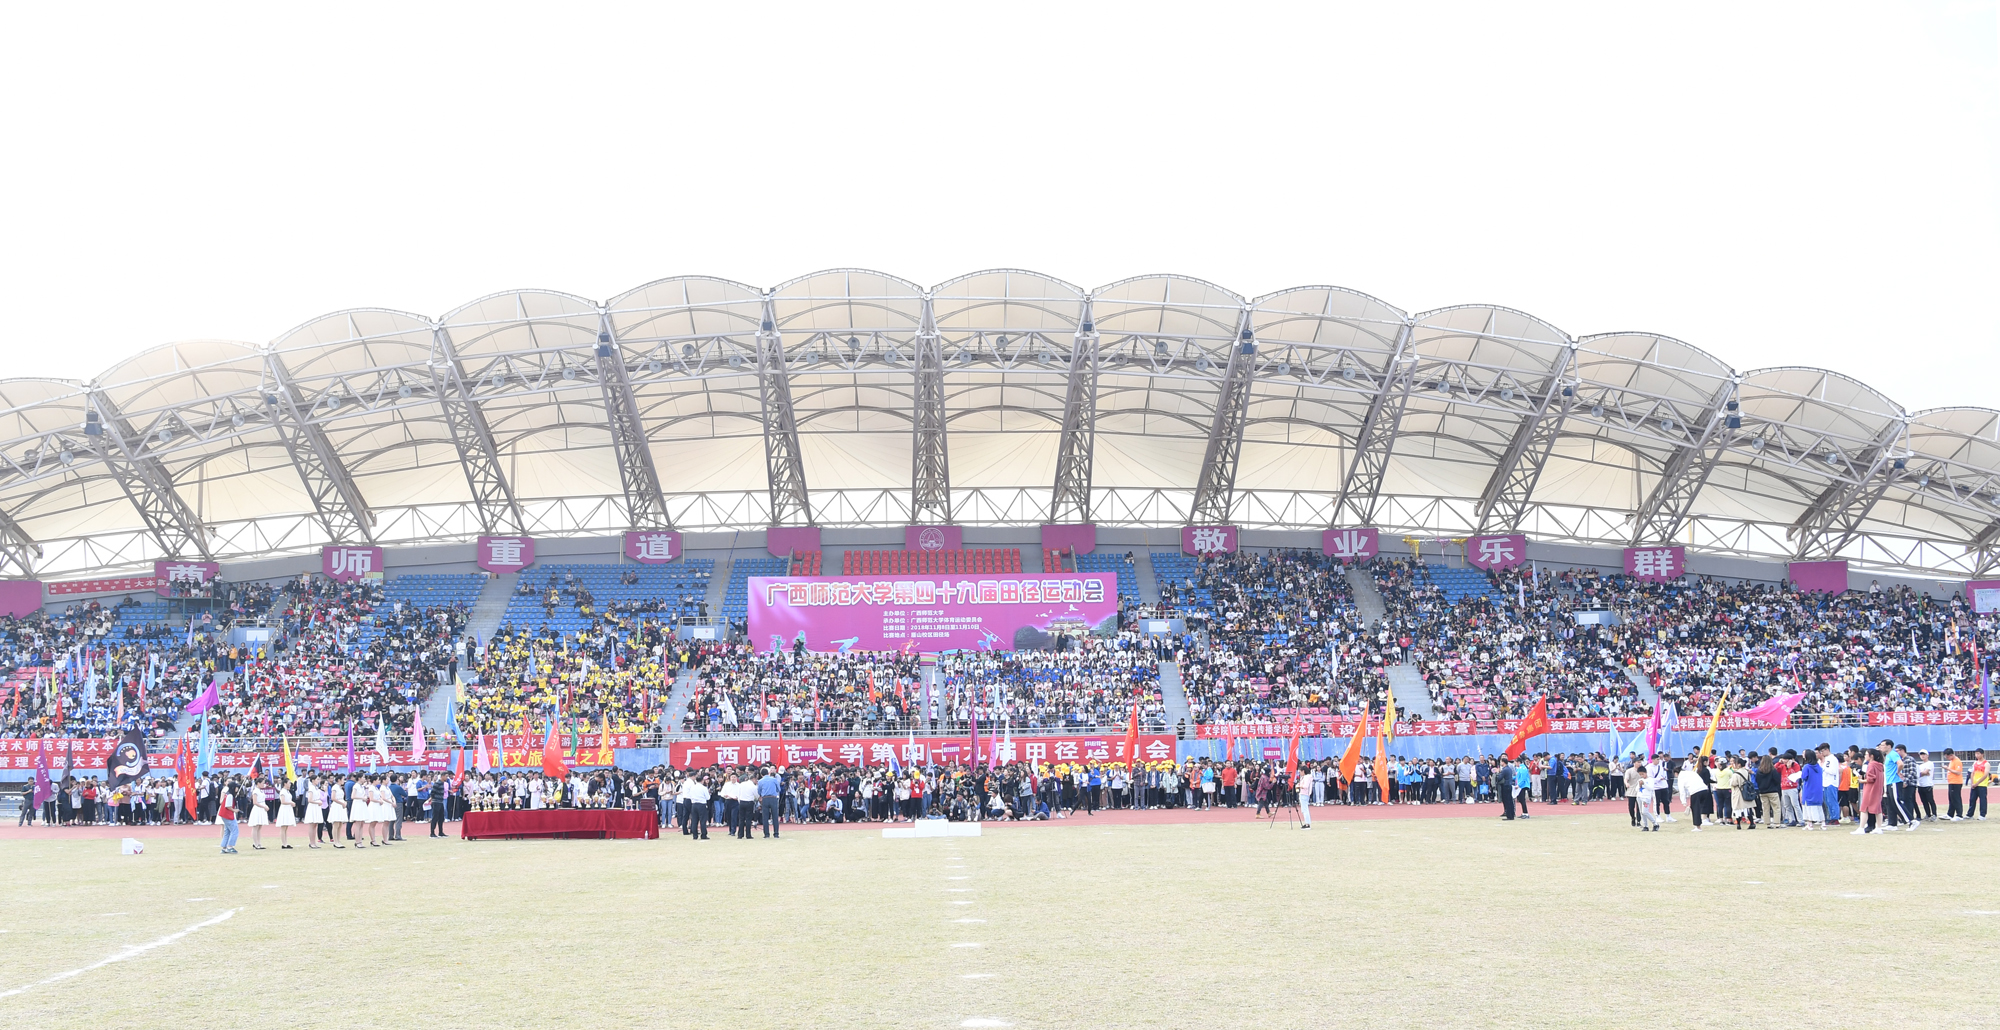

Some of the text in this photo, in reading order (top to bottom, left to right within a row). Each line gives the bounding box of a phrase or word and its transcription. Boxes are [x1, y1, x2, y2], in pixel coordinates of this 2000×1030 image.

[487, 539, 526, 566] 重
[636, 534, 673, 560] 道
[1193, 529, 1228, 554] 敬
[1334, 531, 1371, 557] 业
[1479, 538, 1515, 563] 乐
[332, 550, 372, 577] 师
[1634, 550, 1674, 577] 群
[766, 578, 1104, 607] 广西师范大学第四十九届田径运动会
[493, 736, 629, 748] 历史文化与游学院大本营
